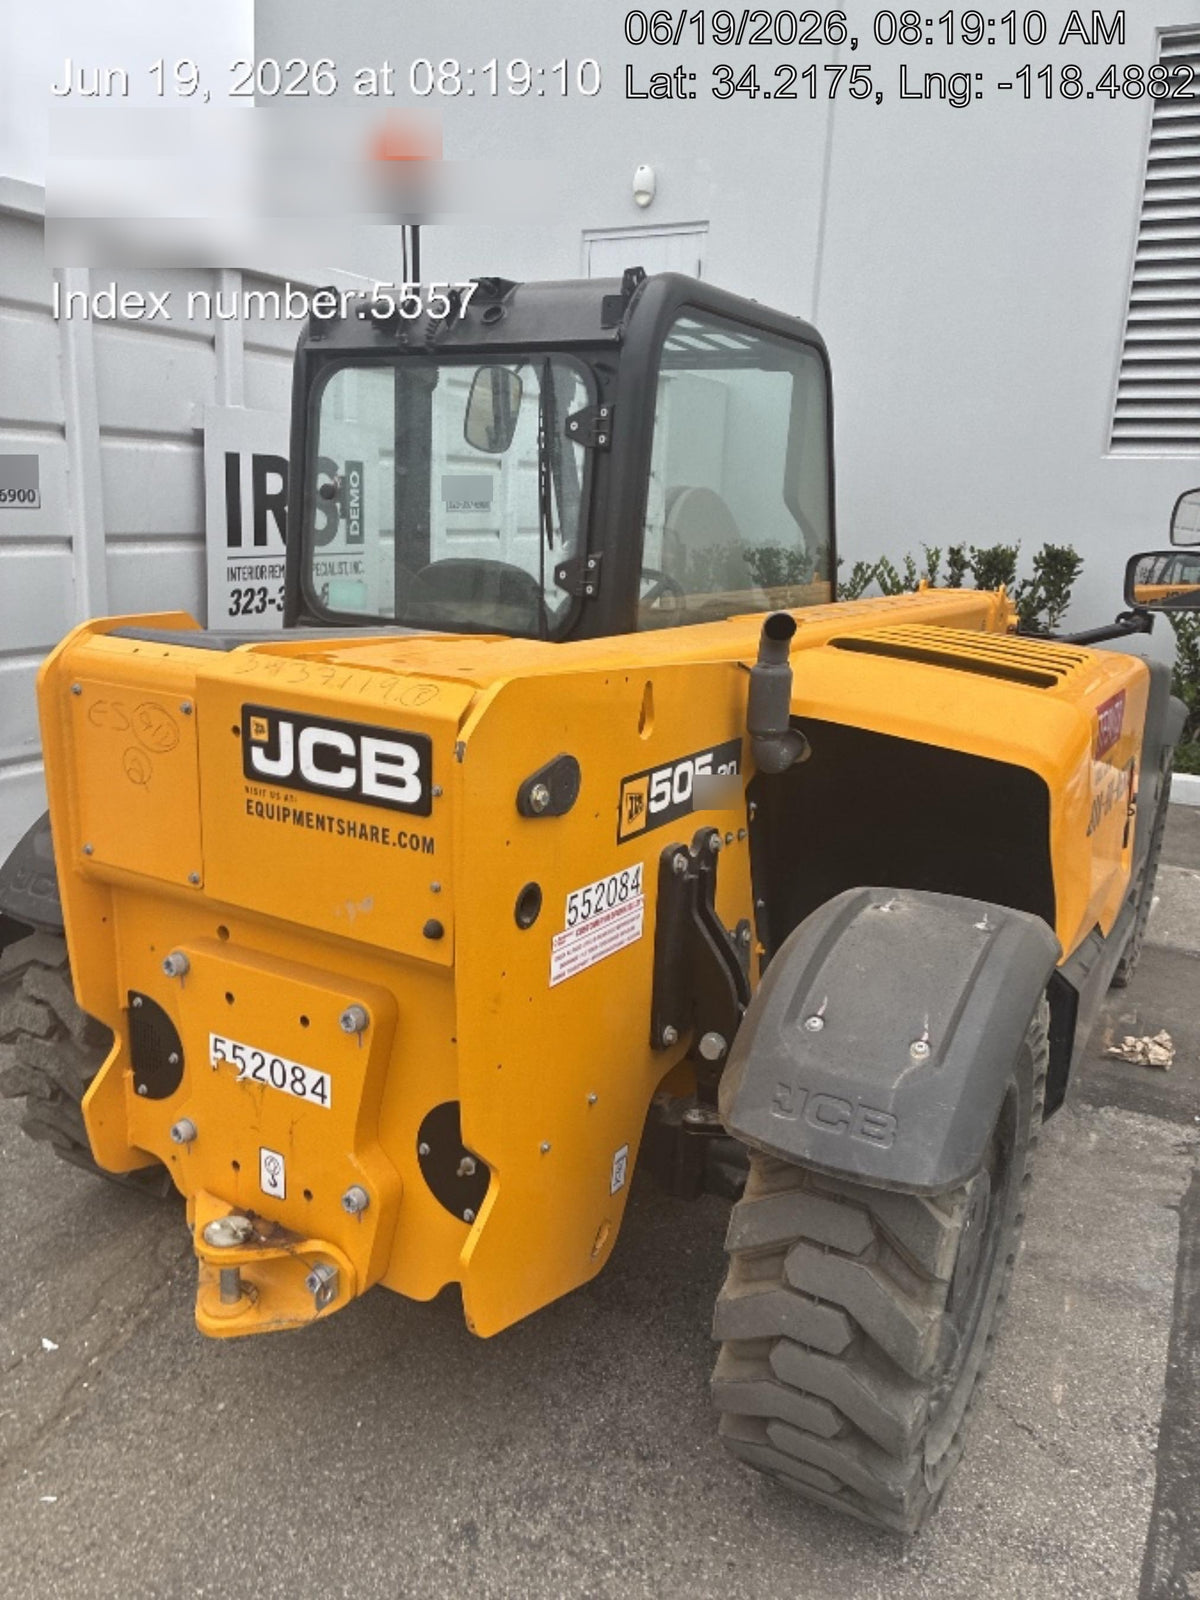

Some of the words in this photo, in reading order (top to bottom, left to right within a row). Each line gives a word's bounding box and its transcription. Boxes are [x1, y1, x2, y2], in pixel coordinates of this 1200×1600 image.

[349, 470, 361, 537] DEMO
[227, 564, 267, 581] INTERIOR
[268, 564, 285, 579] REM
[228, 585, 285, 616] 323-3
[244, 785, 267, 799] VISIT
[269, 789, 282, 801] US
[250, 720, 423, 807] JCB
[245, 798, 435, 856] EQUIPMENTSHARE.COM
[567, 865, 641, 926] 552084
[212, 1036, 328, 1105] 552084
[770, 1081, 899, 1150] JCB
